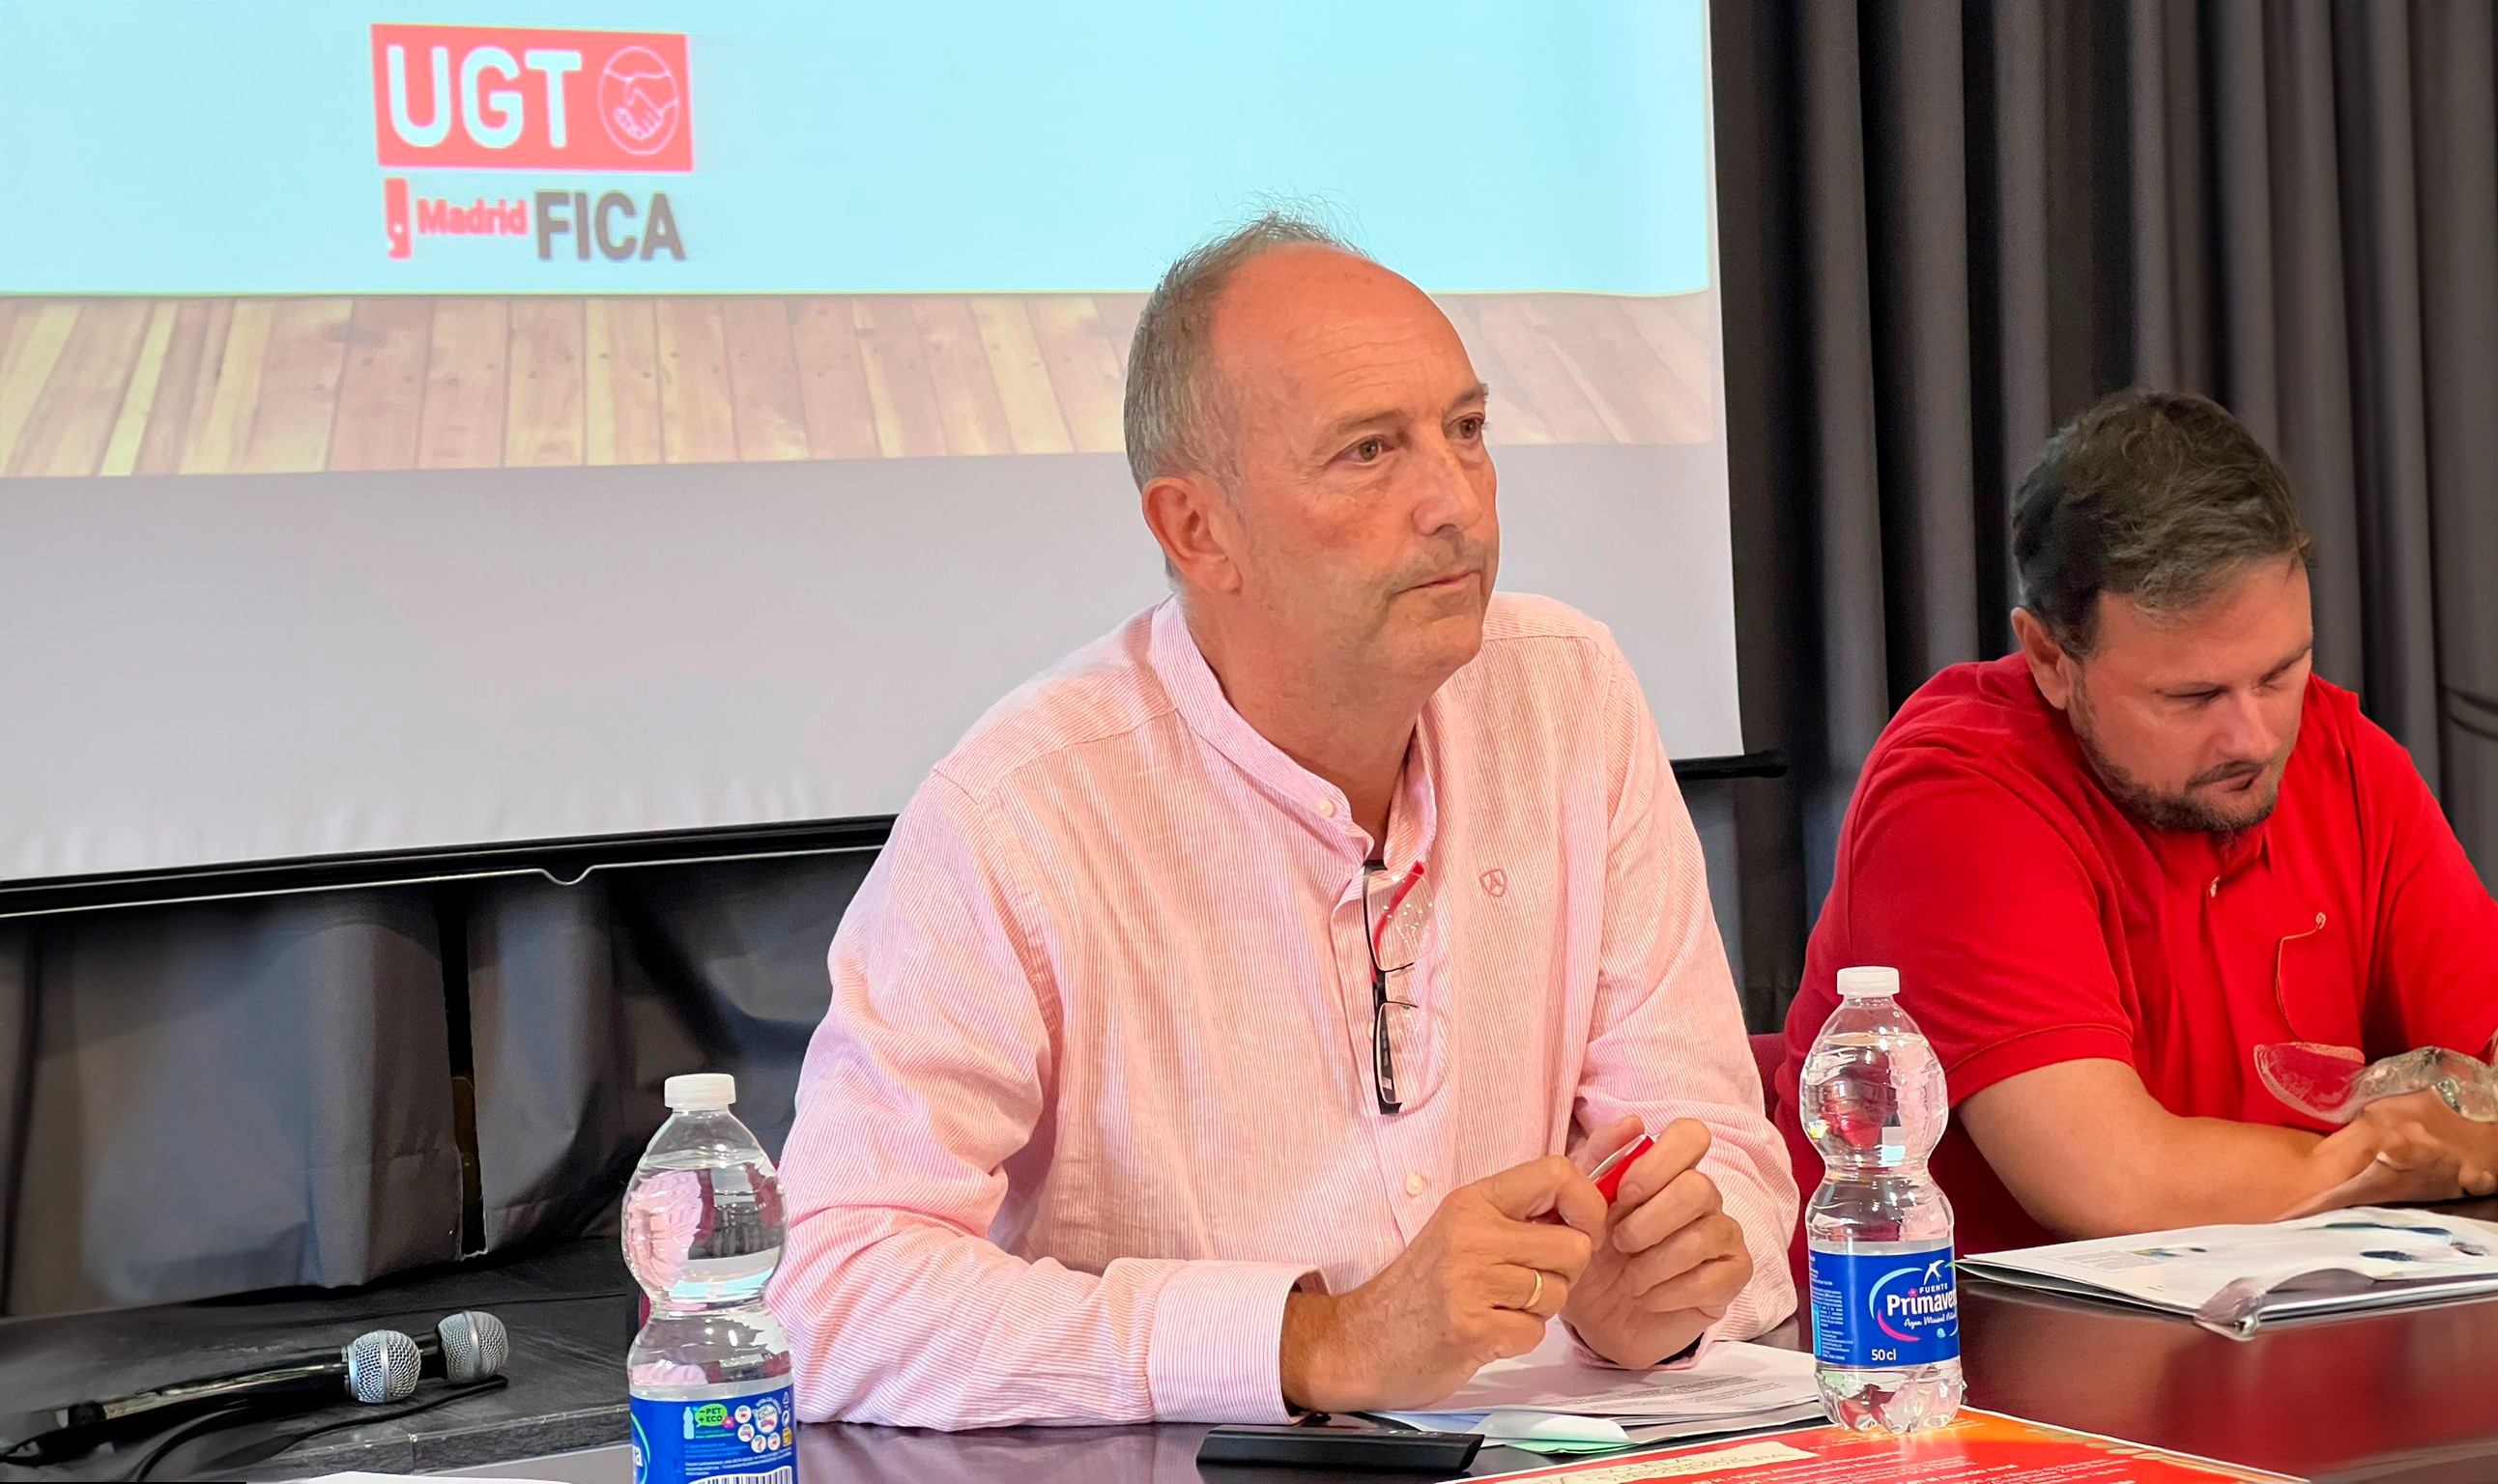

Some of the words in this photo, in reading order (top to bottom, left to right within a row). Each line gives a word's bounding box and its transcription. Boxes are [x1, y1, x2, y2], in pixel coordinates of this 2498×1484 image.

[387, 44, 582, 149] UGT
[416, 197, 529, 235] Madrid
[534, 189, 686, 261] FICA
[1919, 1283, 1948, 1294] FUENTE
